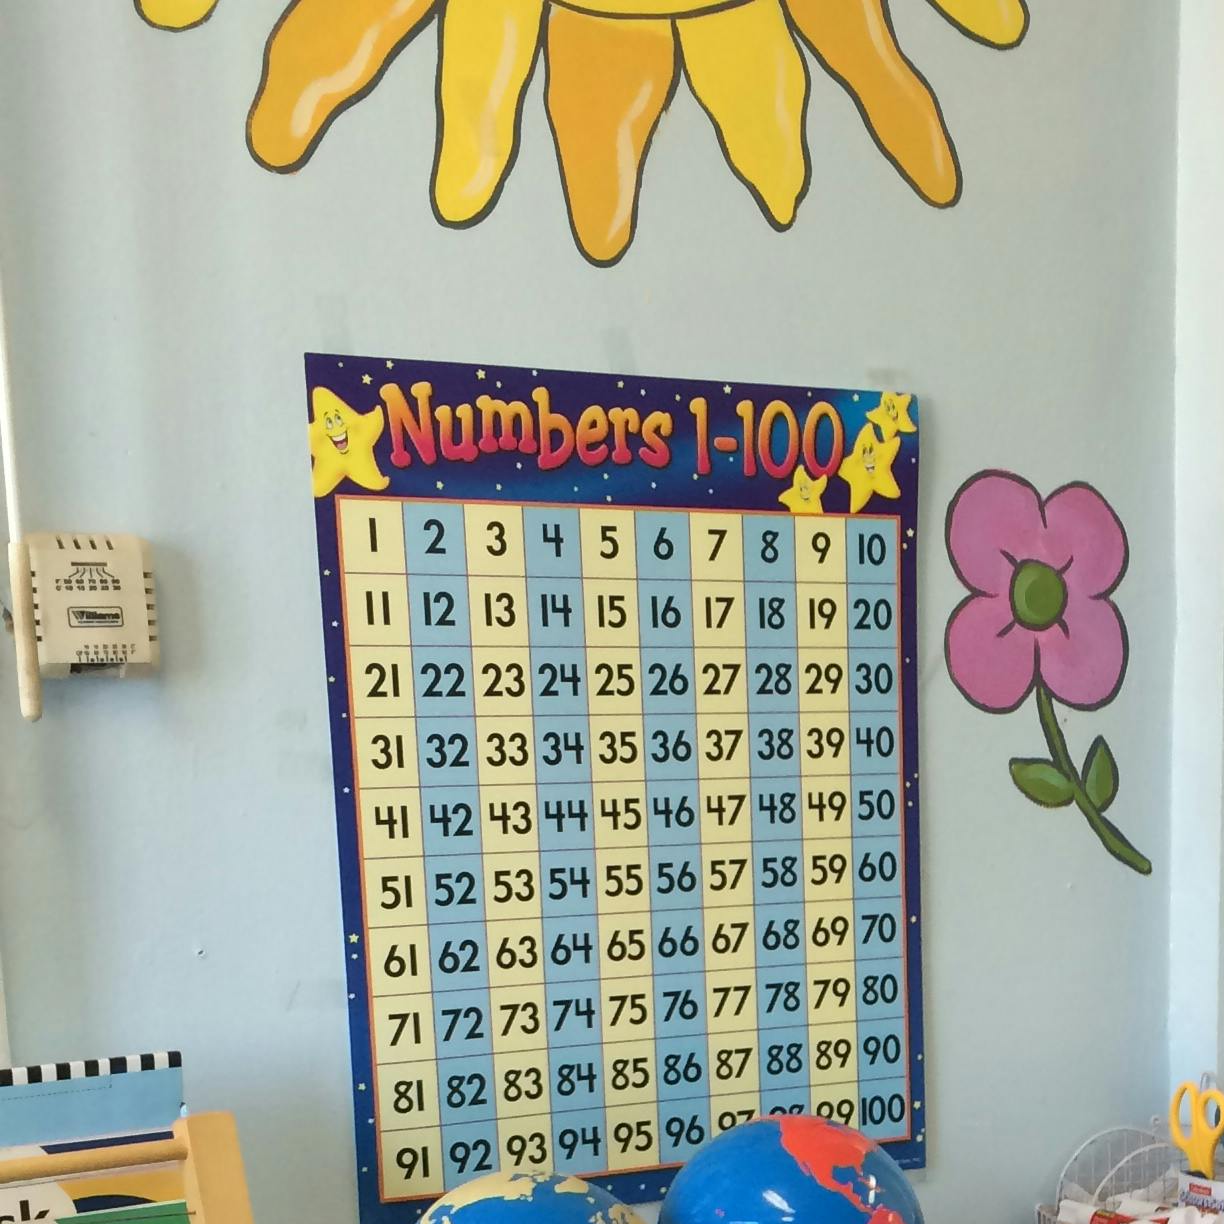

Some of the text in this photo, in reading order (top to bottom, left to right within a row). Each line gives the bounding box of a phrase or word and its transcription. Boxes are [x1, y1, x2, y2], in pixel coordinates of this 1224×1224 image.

[378, 381, 844, 478] Numbers 1-100
[368, 517, 887, 566] 1 2 3 4 5 6 7 8 9 10
[365, 591, 893, 631] 11 12 13 14 15 16 17 18 19 20
[365, 662, 893, 698] 21 22 23 24 25 26 27 28 29 30
[371, 726, 895, 770] 31 32 33 34 35 36 37 38 39 40
[374, 789, 896, 839] 41 42 43 44 45 46 47 48 49 50
[380, 851, 897, 910] 51 52 53 54 55 56 57 58 59 60
[384, 913, 897, 978] 61 62 63 64 65 66 67 68 69 70
[388, 974, 898, 1047] 71 72 73 74 75 76 77 78 79 80
[393, 1034, 901, 1114] 81 82 83 84 85 86 87 88 89 90
[396, 1146, 430, 1180] 91
[449, 1138, 493, 1174] 92
[506, 1132, 547, 1167] 93
[558, 1126, 602, 1160] 94
[613, 1120, 653, 1154] 95
[665, 1114, 705, 1148] 96
[861, 1093, 906, 1126] 100
